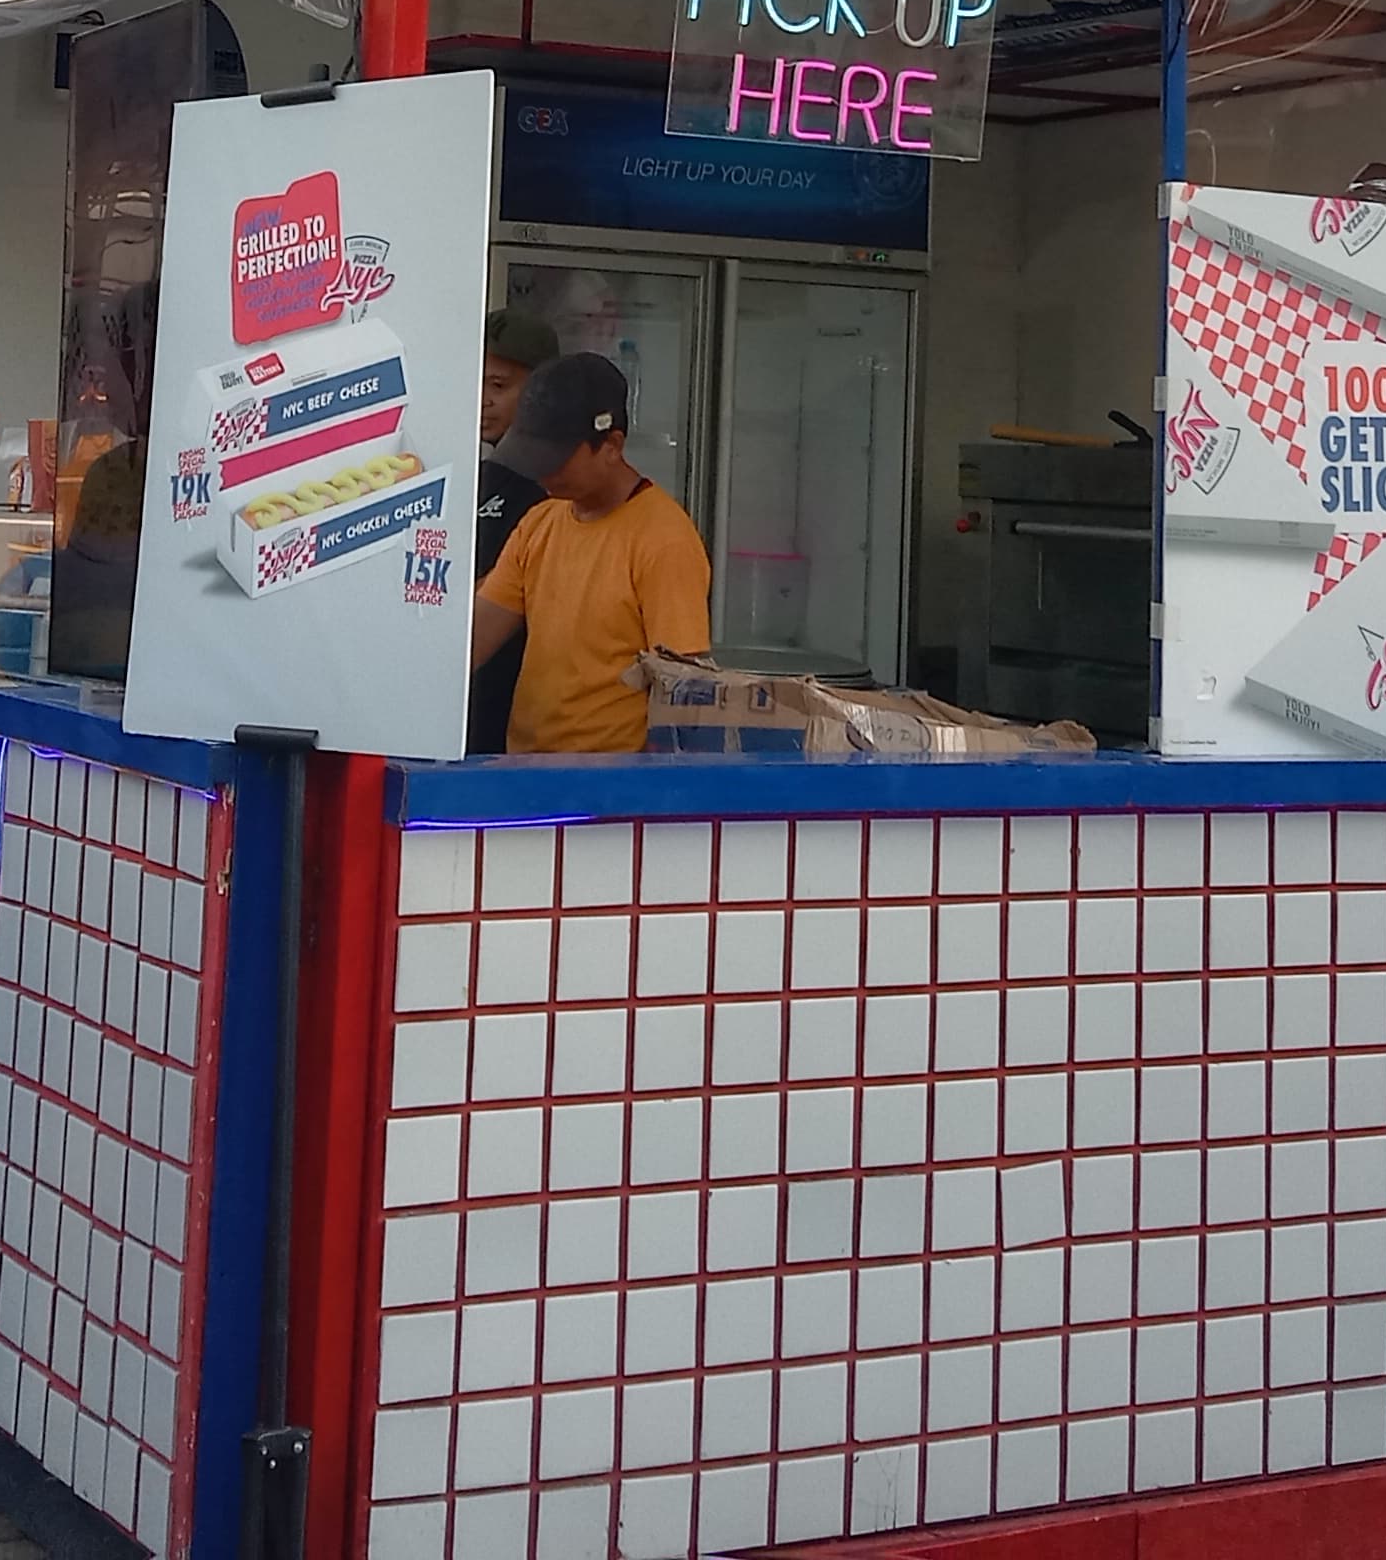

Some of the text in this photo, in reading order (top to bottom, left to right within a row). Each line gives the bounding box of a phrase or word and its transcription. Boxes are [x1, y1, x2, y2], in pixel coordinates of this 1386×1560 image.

[726, 52, 938, 149] HERE
[623, 156, 816, 190] LIGHT UP YOUR DAY
[237, 214, 326, 259] GRILLED TO
[237, 234, 338, 284] PERFECTION!
[352, 253, 377, 266] PIZZA
[282, 400, 304, 419] NYC
[307, 391, 335, 412] BEEF
[339, 377, 380, 401] CHEESE
[1194, 435, 1219, 473] PIZZA
[171, 471, 212, 507] 19K
[321, 495, 434, 550] NYC CHICKEN CHEESE
[404, 550, 453, 595] 15K
[1284, 695, 1311, 717] YOLO
[1286, 710, 1321, 731] ENJOY!
